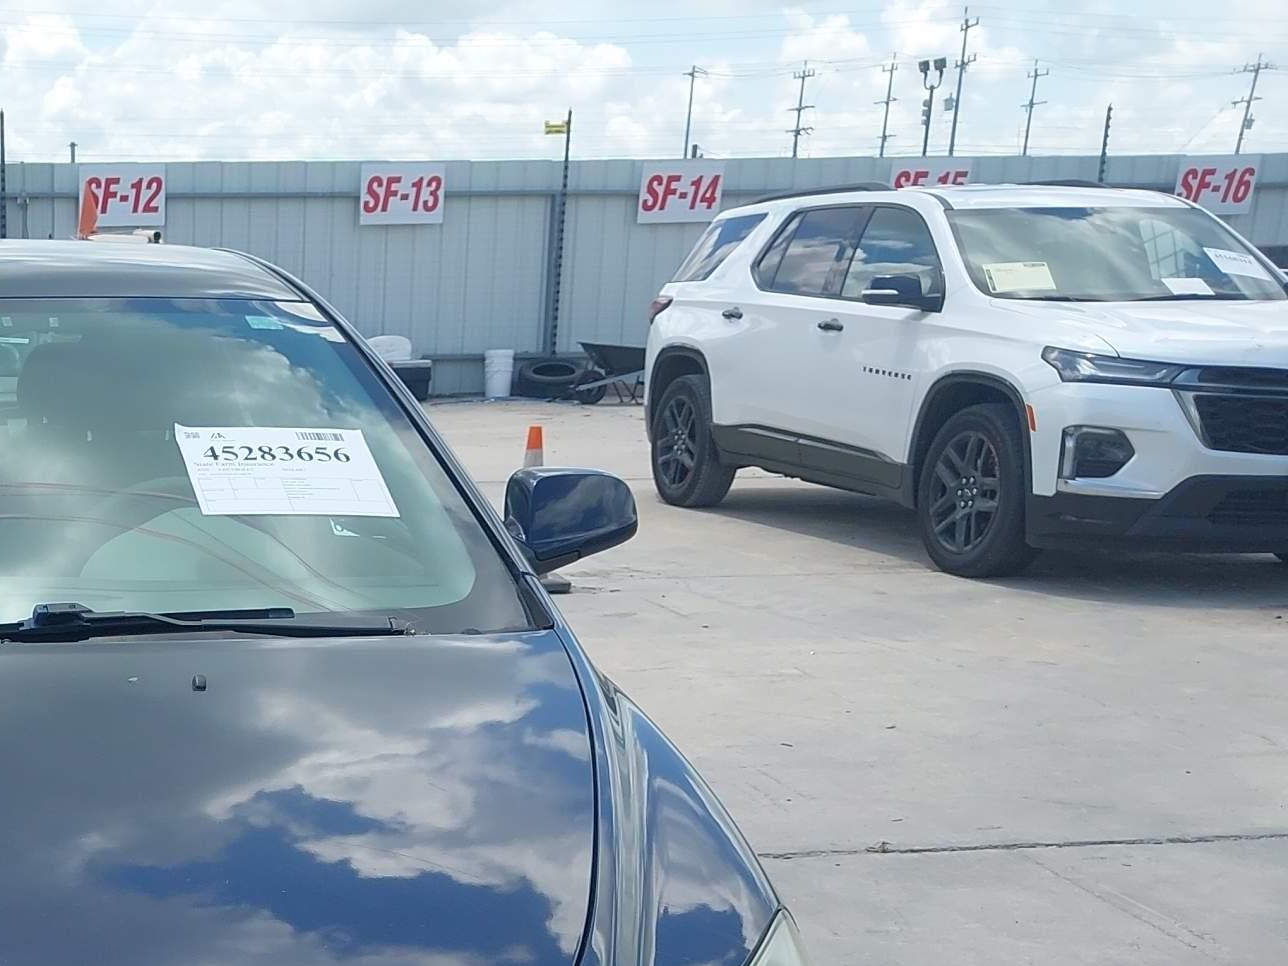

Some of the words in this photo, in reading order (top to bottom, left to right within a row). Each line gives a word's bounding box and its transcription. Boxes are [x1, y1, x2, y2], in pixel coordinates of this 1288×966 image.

[86, 176, 163, 214] SF-12
[363, 175, 442, 213] SF-13
[642, 174, 721, 211] SF-14
[1176, 167, 1256, 203] SF-16
[203, 445, 351, 463] 45283656
